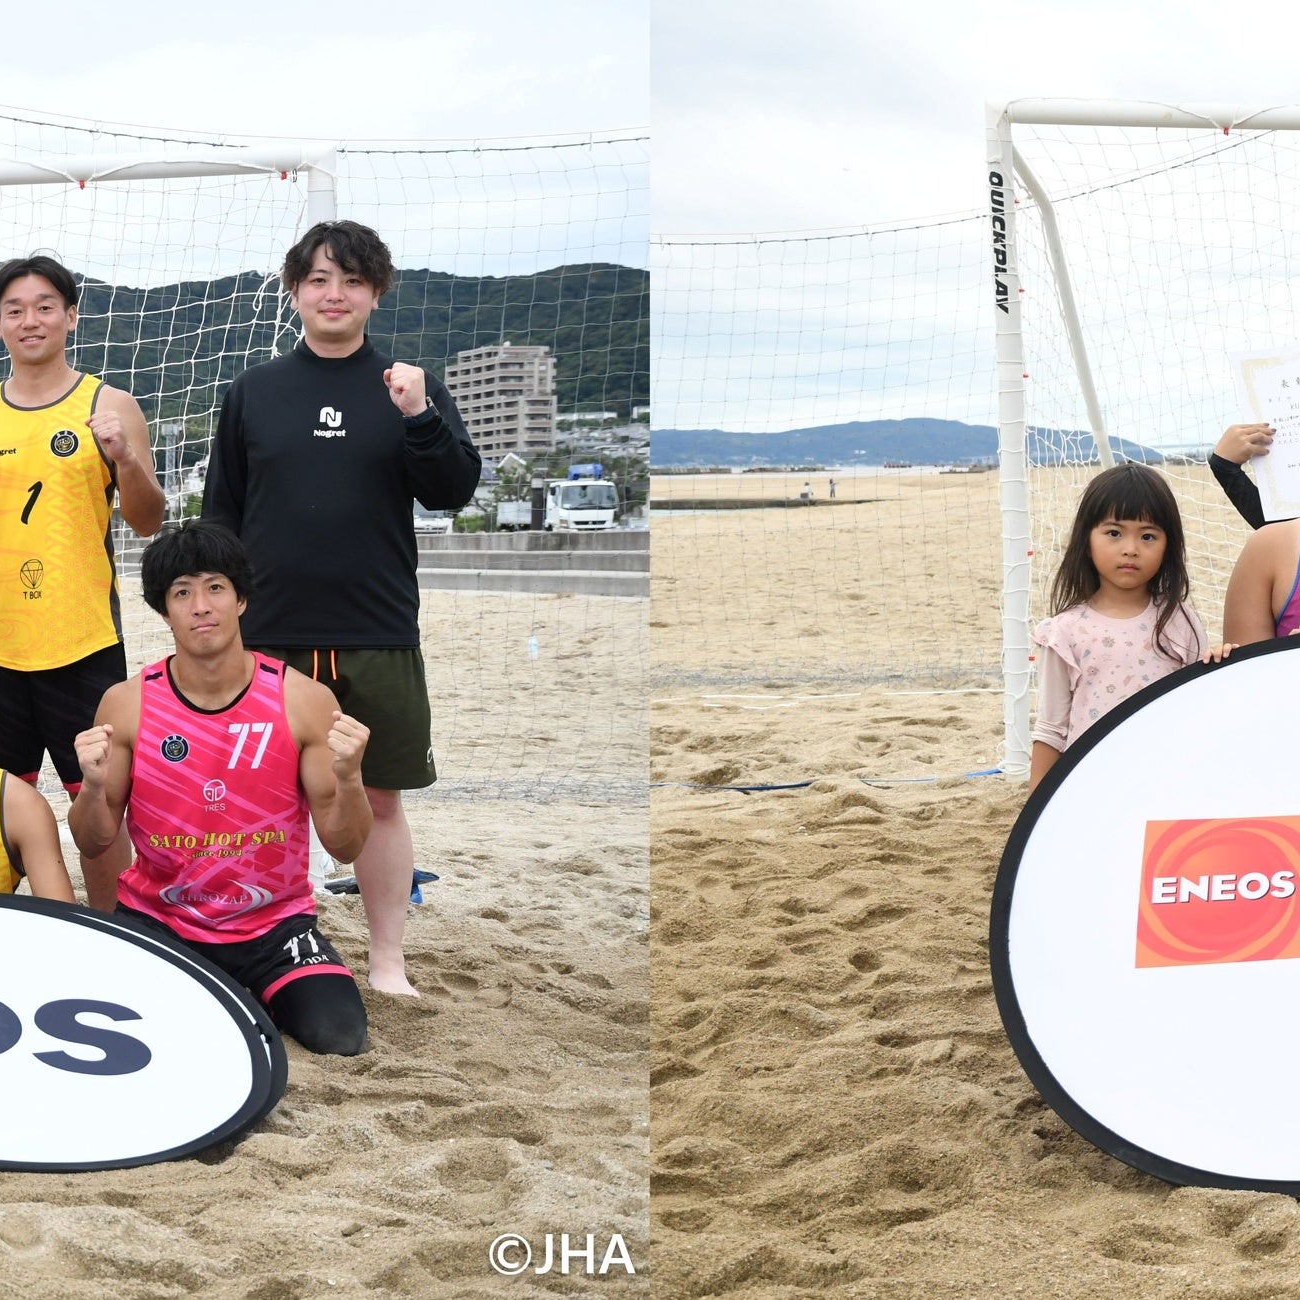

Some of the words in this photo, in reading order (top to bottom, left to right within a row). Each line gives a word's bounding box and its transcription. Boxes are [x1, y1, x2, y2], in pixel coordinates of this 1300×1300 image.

[989, 171, 1009, 314] QUICKPLAY
[313, 429, 346, 438] Nogret
[21, 481, 43, 525] 1
[227, 722, 273, 769] 77
[204, 803, 226, 812] TRES
[150, 834, 197, 849] SATO
[203, 832, 246, 847] HOT
[251, 830, 286, 845] SPA
[217, 849, 242, 858] 1994
[1153, 872, 1295, 904] ENEOS
